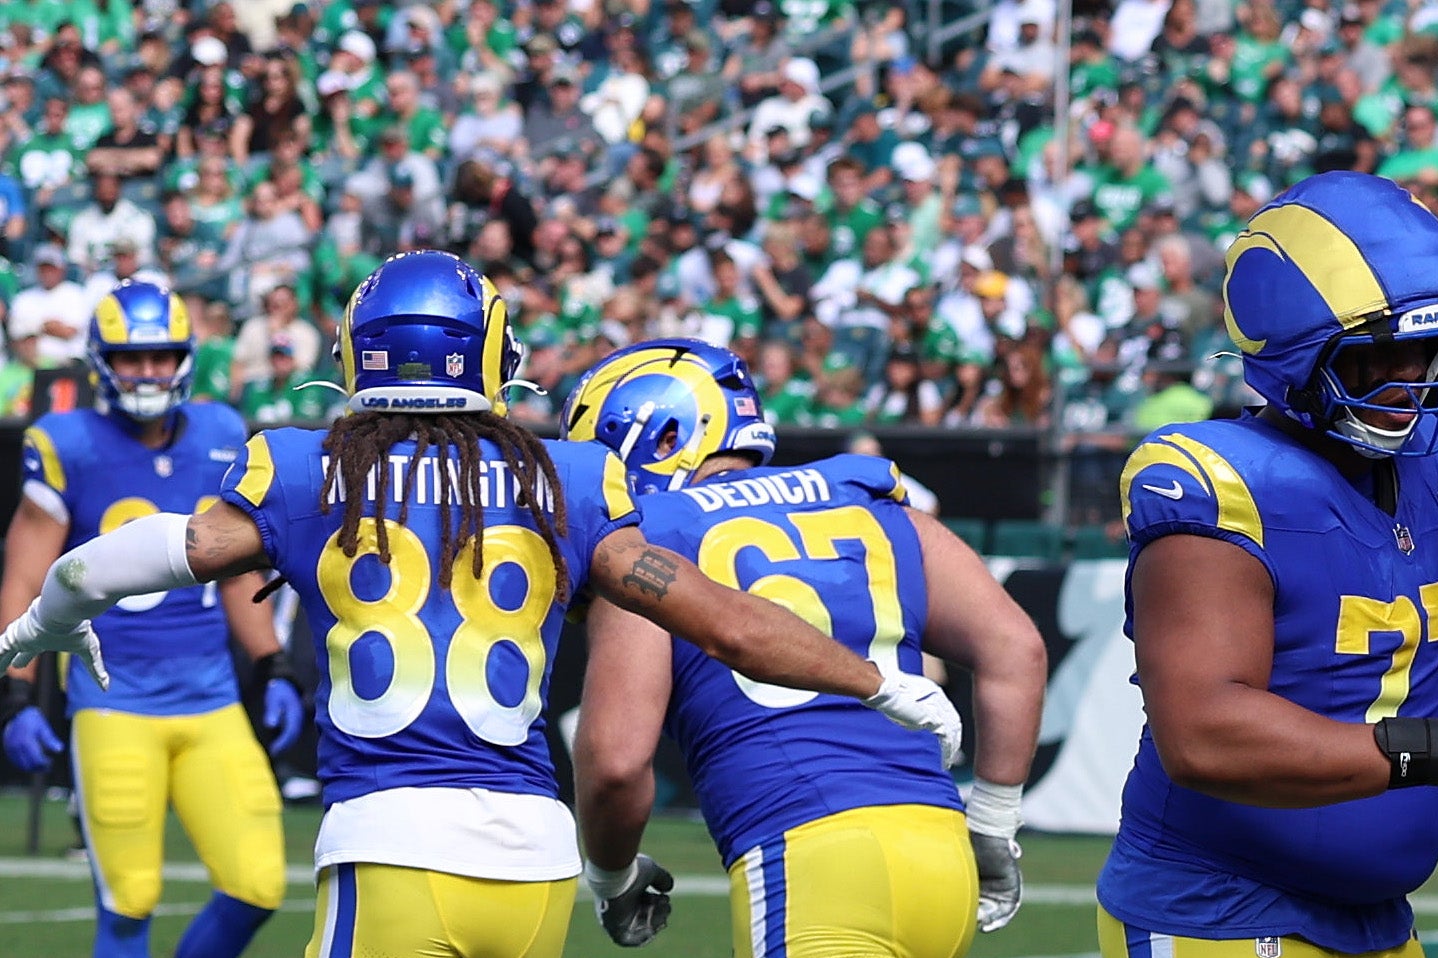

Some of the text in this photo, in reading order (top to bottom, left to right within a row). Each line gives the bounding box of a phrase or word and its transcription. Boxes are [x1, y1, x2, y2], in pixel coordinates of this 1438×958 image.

[361, 397, 467, 409] LOS ANGELES
[321, 454, 555, 514] WTTINGTN
[682, 468, 831, 513] DEDICH
[316, 516, 557, 747] 88
[697, 504, 906, 709] 67
